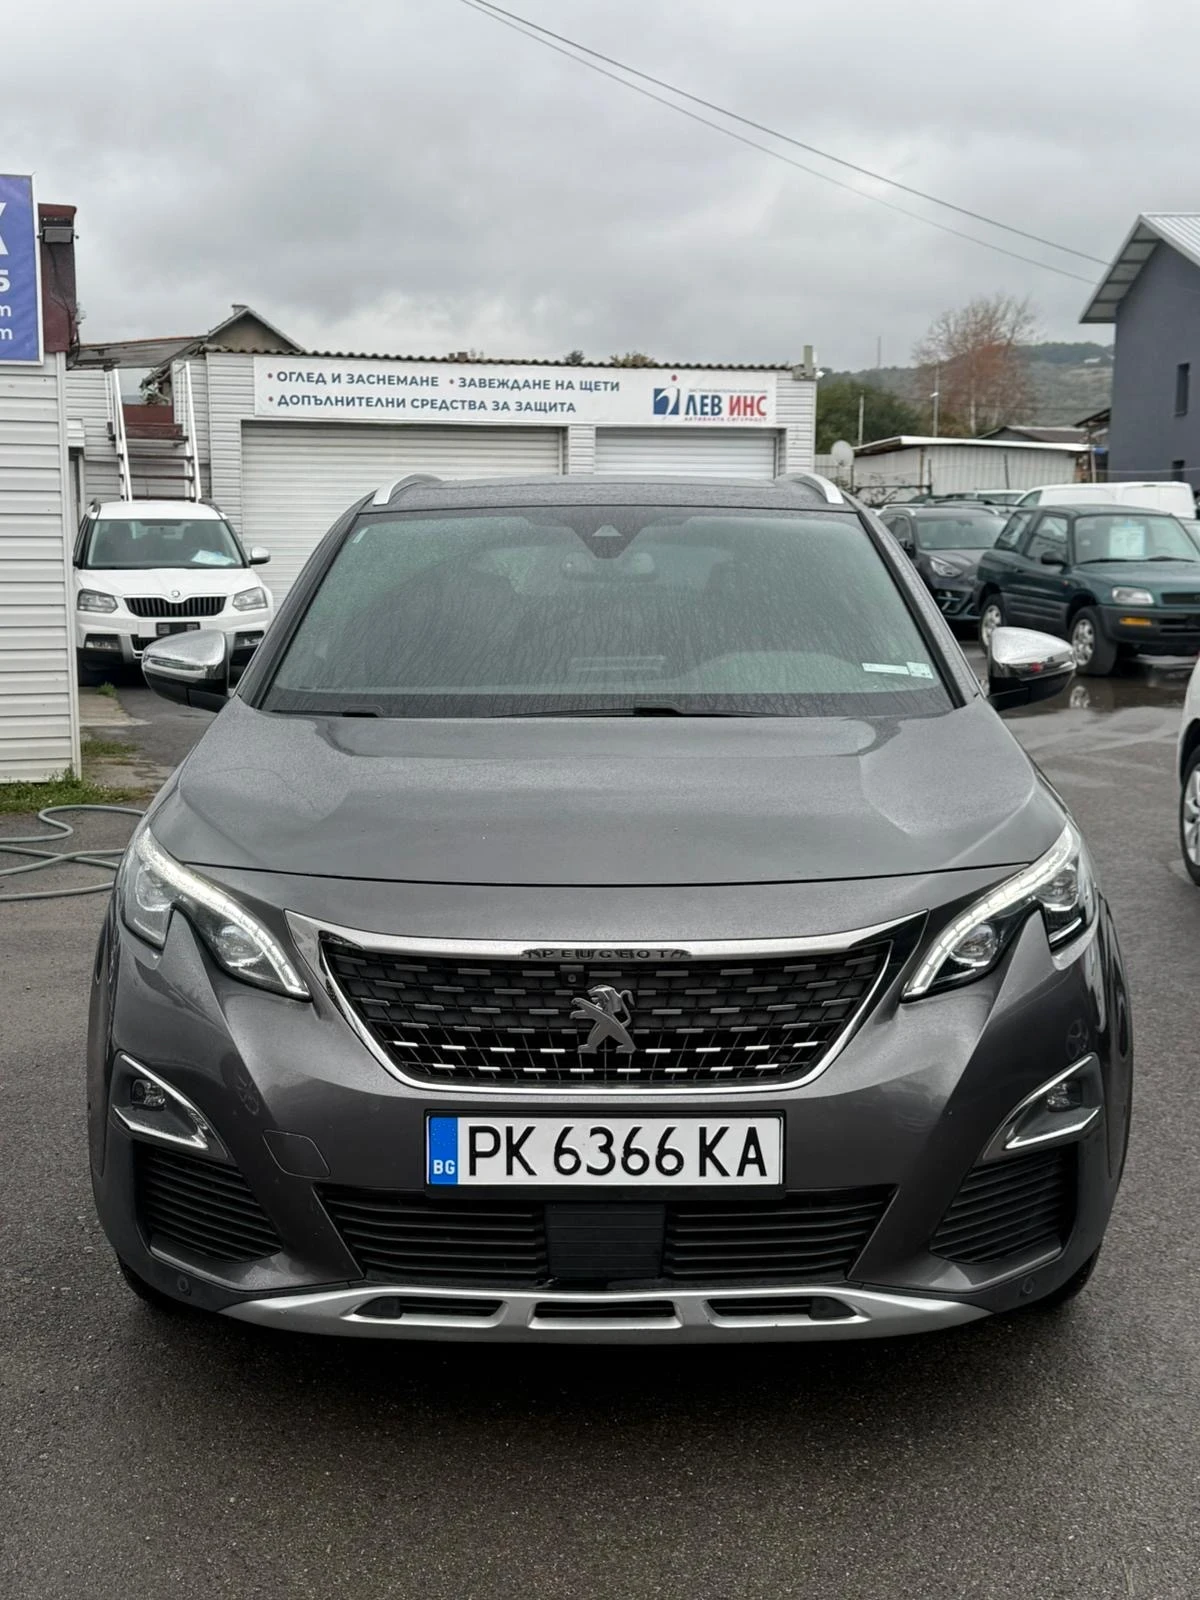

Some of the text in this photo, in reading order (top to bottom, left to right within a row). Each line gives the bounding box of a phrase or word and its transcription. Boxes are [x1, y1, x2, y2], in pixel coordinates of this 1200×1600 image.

[277, 371, 439, 387] ОГЛЕД И ЗАСНЕМАНЕ
[458, 377, 620, 393] ЗАВЕЖДАНЕ НА ЩЕТИ
[277, 394, 576, 413] ДОПЪЛНИТЕЛНИ СРЕДСТВА ЗА ЗАЩИТА
[684, 394, 767, 416] ЛЕВ ИНС
[541, 949, 668, 959] PEUGEOT
[433, 1125, 767, 1177] BG PK 6366 KA
